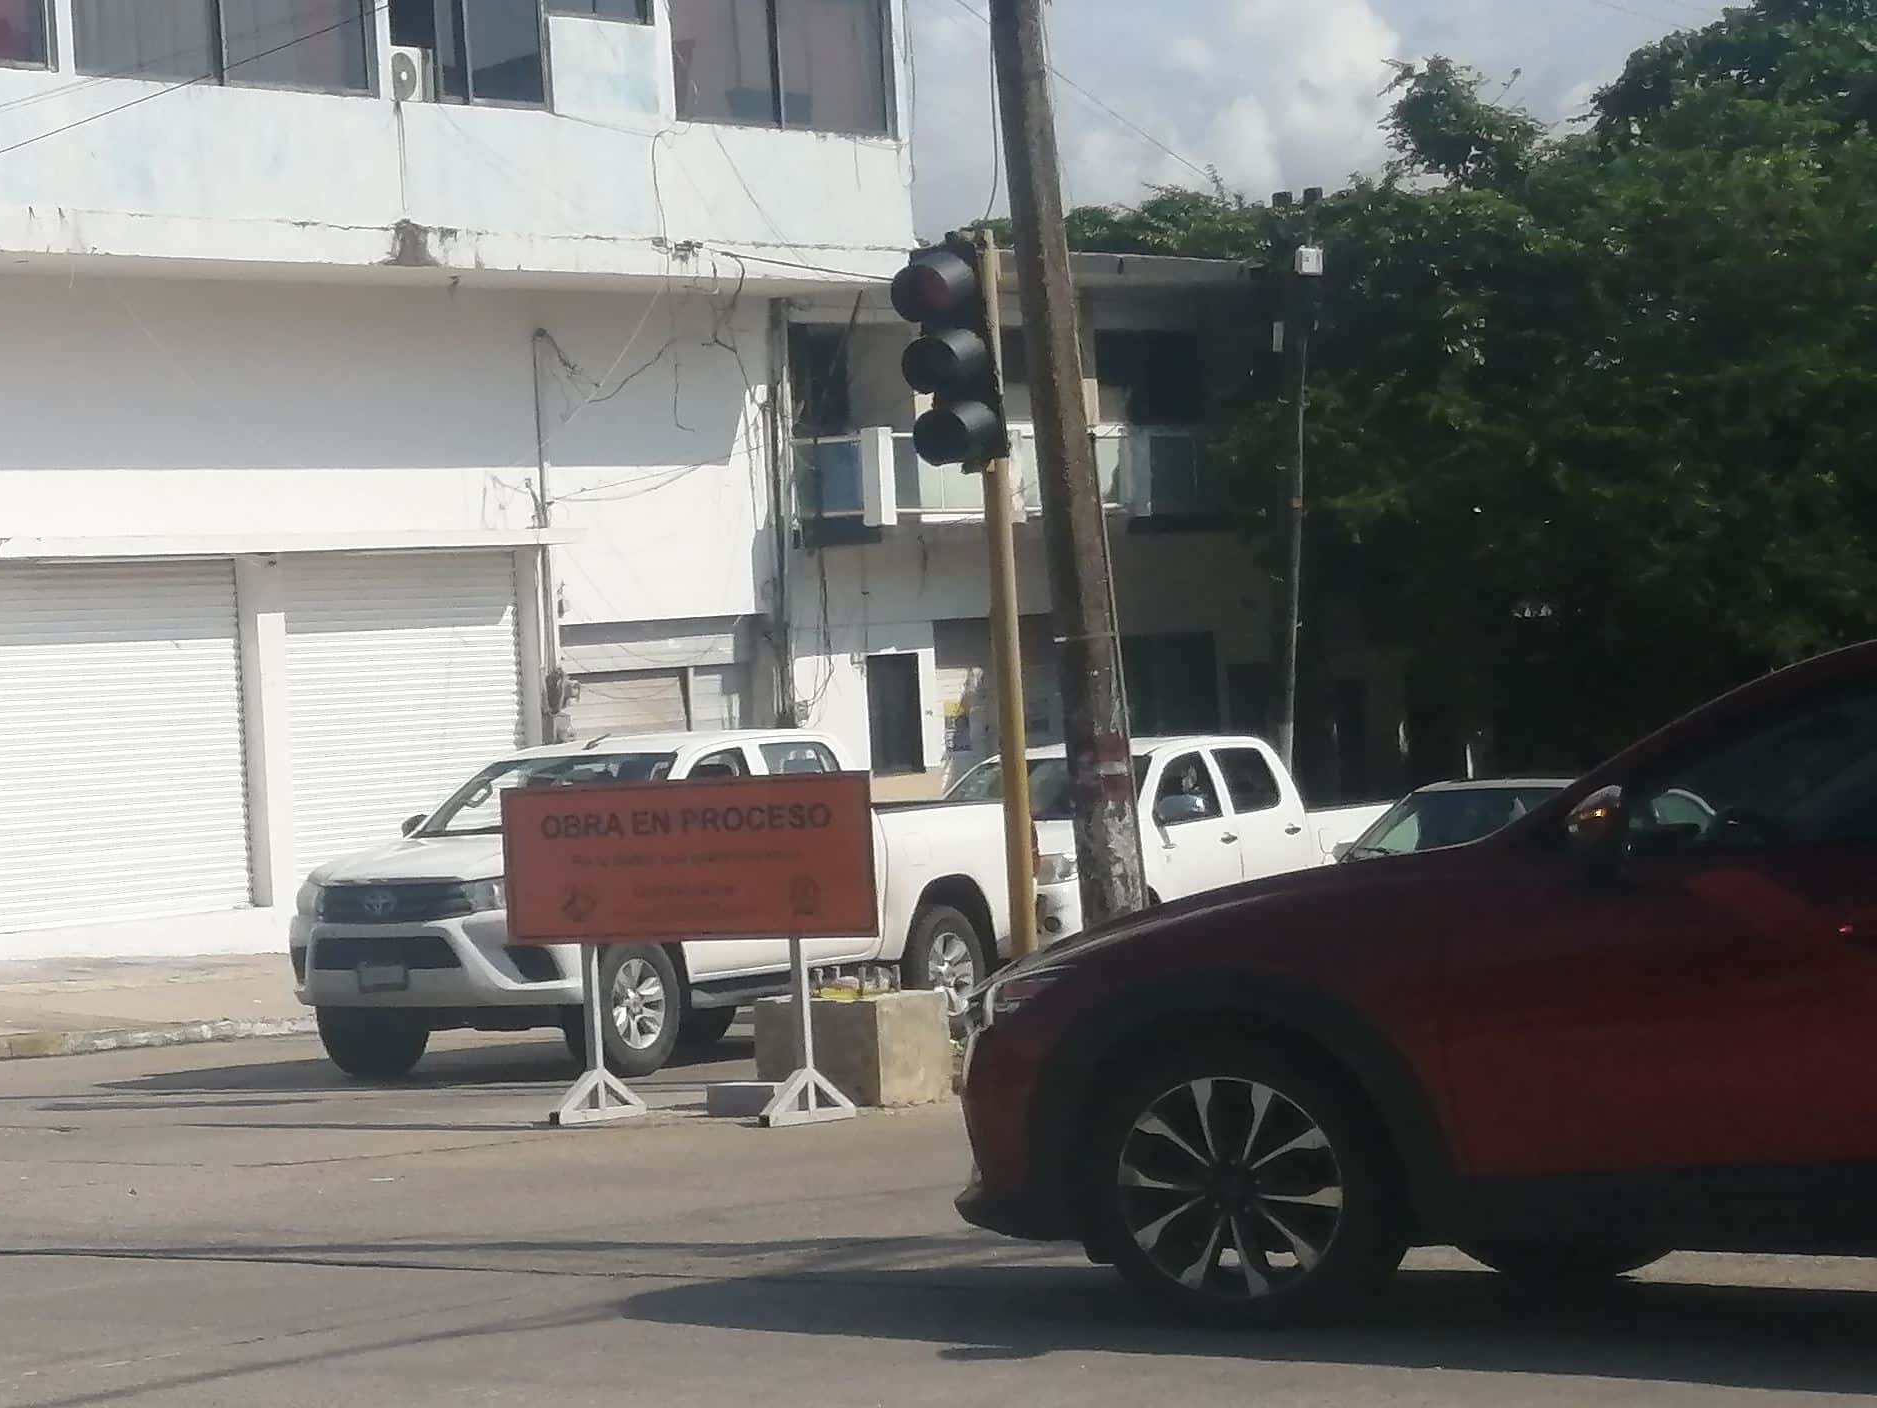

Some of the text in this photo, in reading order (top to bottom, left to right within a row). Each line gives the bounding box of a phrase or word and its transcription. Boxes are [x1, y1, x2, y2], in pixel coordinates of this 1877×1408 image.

[541, 802, 831, 839] OBRA EN PROCESO
